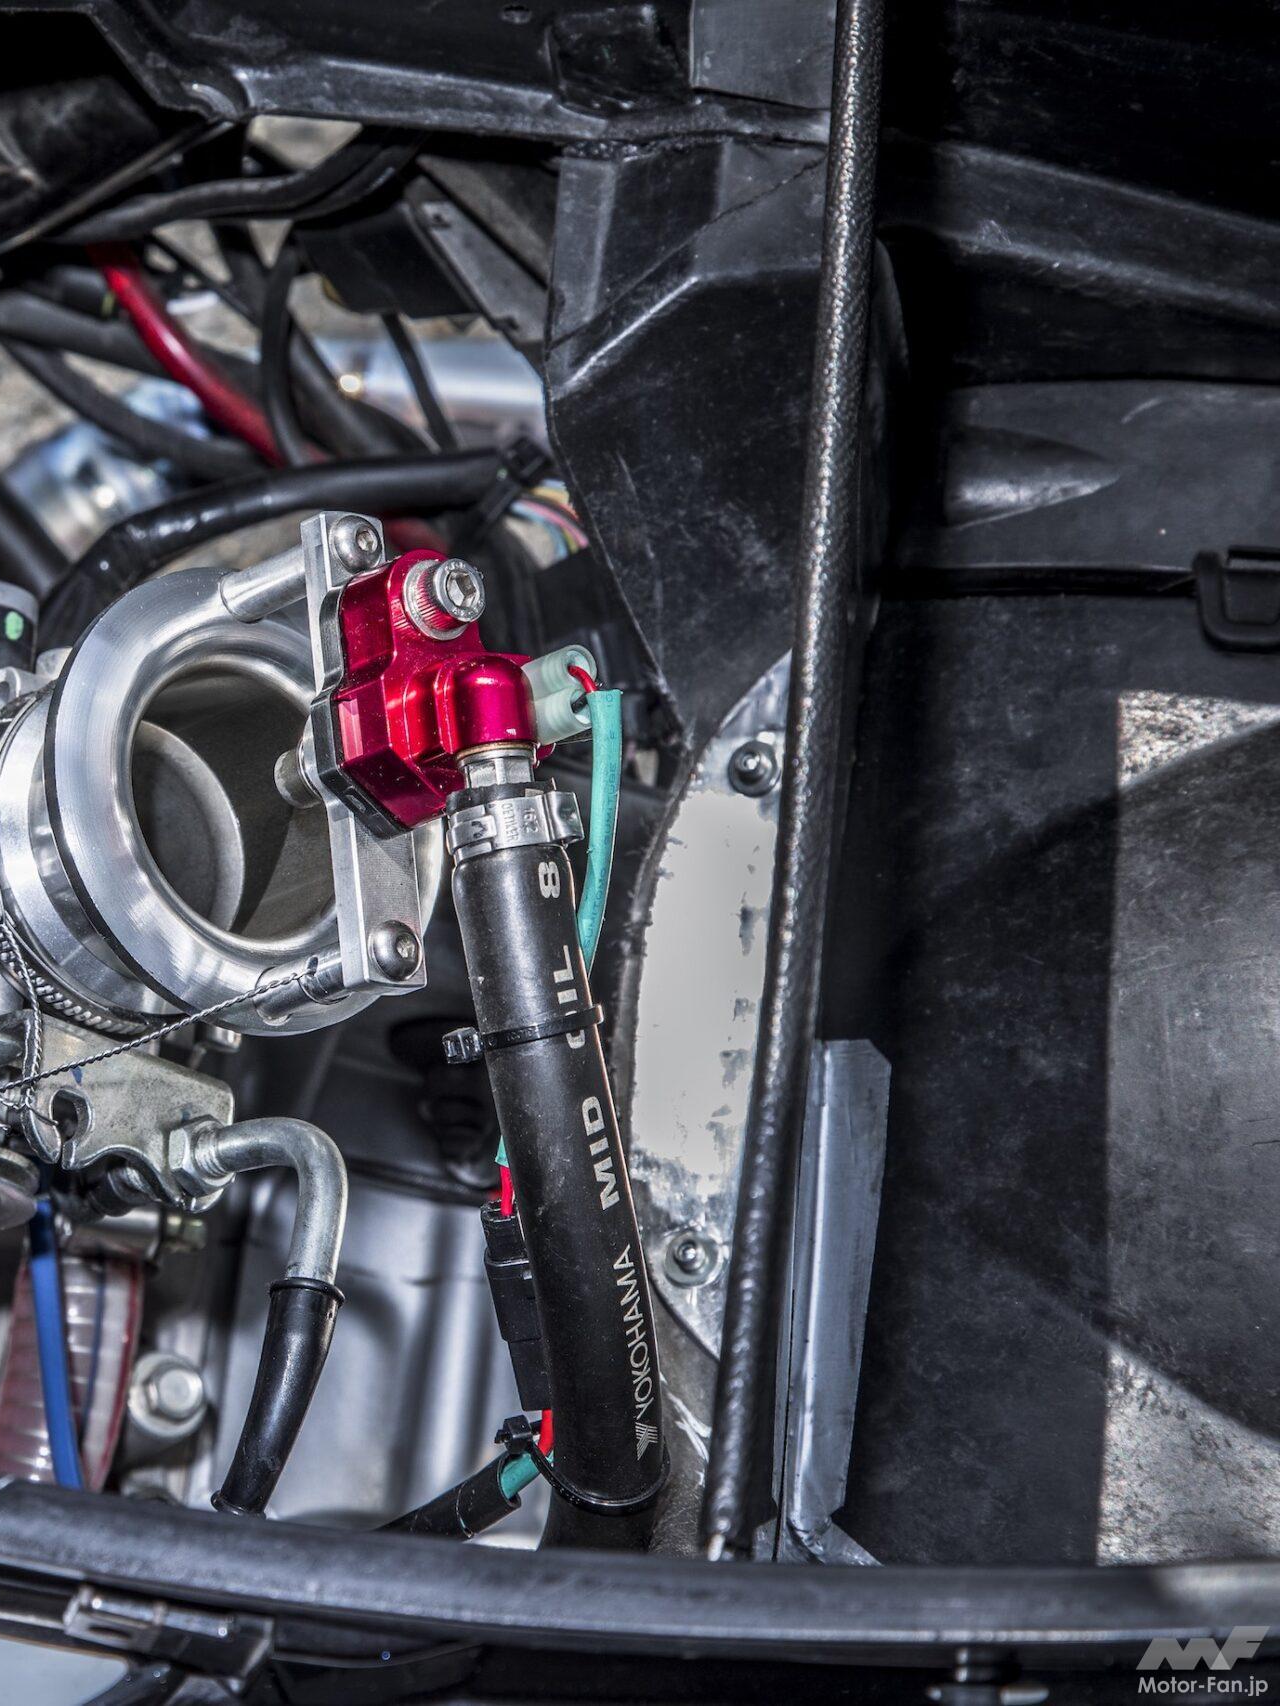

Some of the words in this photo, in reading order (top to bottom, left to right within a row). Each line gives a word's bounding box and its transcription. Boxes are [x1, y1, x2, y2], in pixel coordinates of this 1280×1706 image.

[538, 861, 560, 899] 8
[582, 1096, 620, 1211] MID
[613, 1243, 655, 1421] YOKOHAMA
